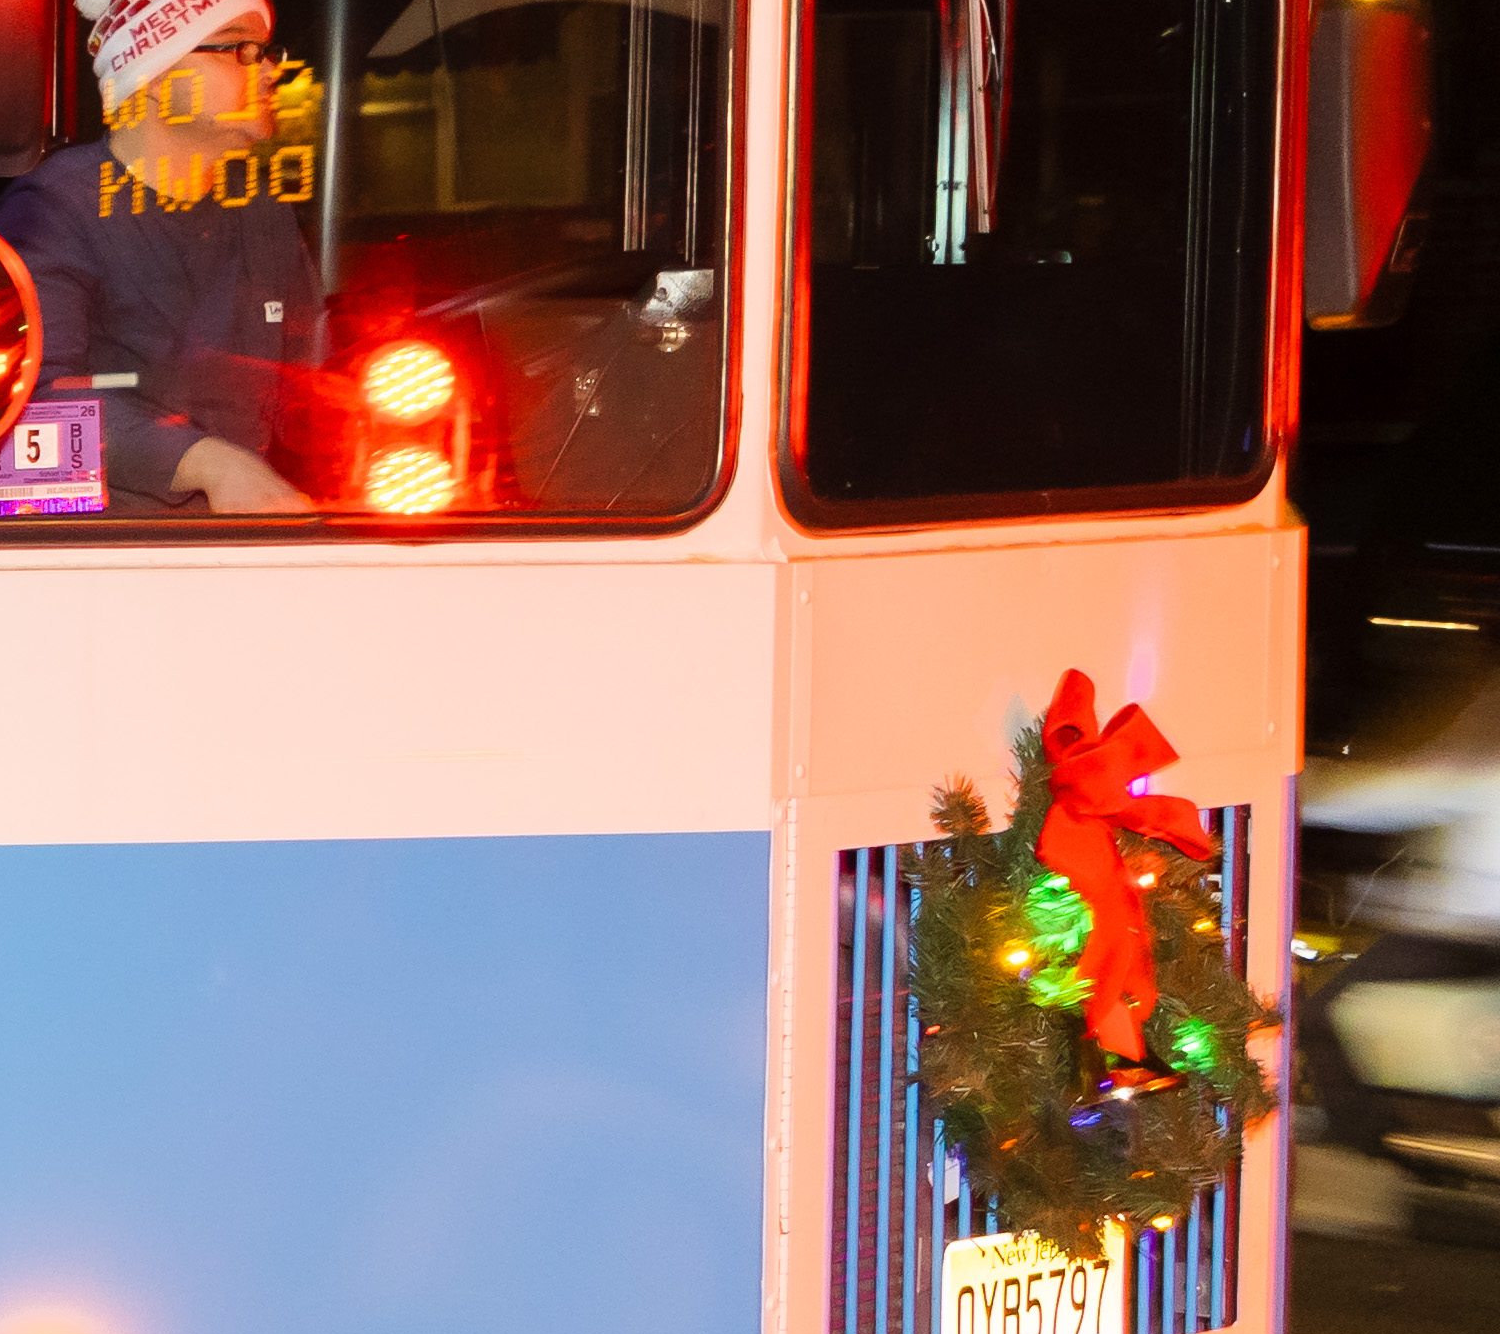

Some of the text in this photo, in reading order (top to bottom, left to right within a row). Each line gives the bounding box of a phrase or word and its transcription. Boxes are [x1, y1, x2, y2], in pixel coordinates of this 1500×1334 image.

[26, 429, 41, 464] 5
[70, 423, 83, 469] BUS
[991, 1244, 1030, 1269] New
